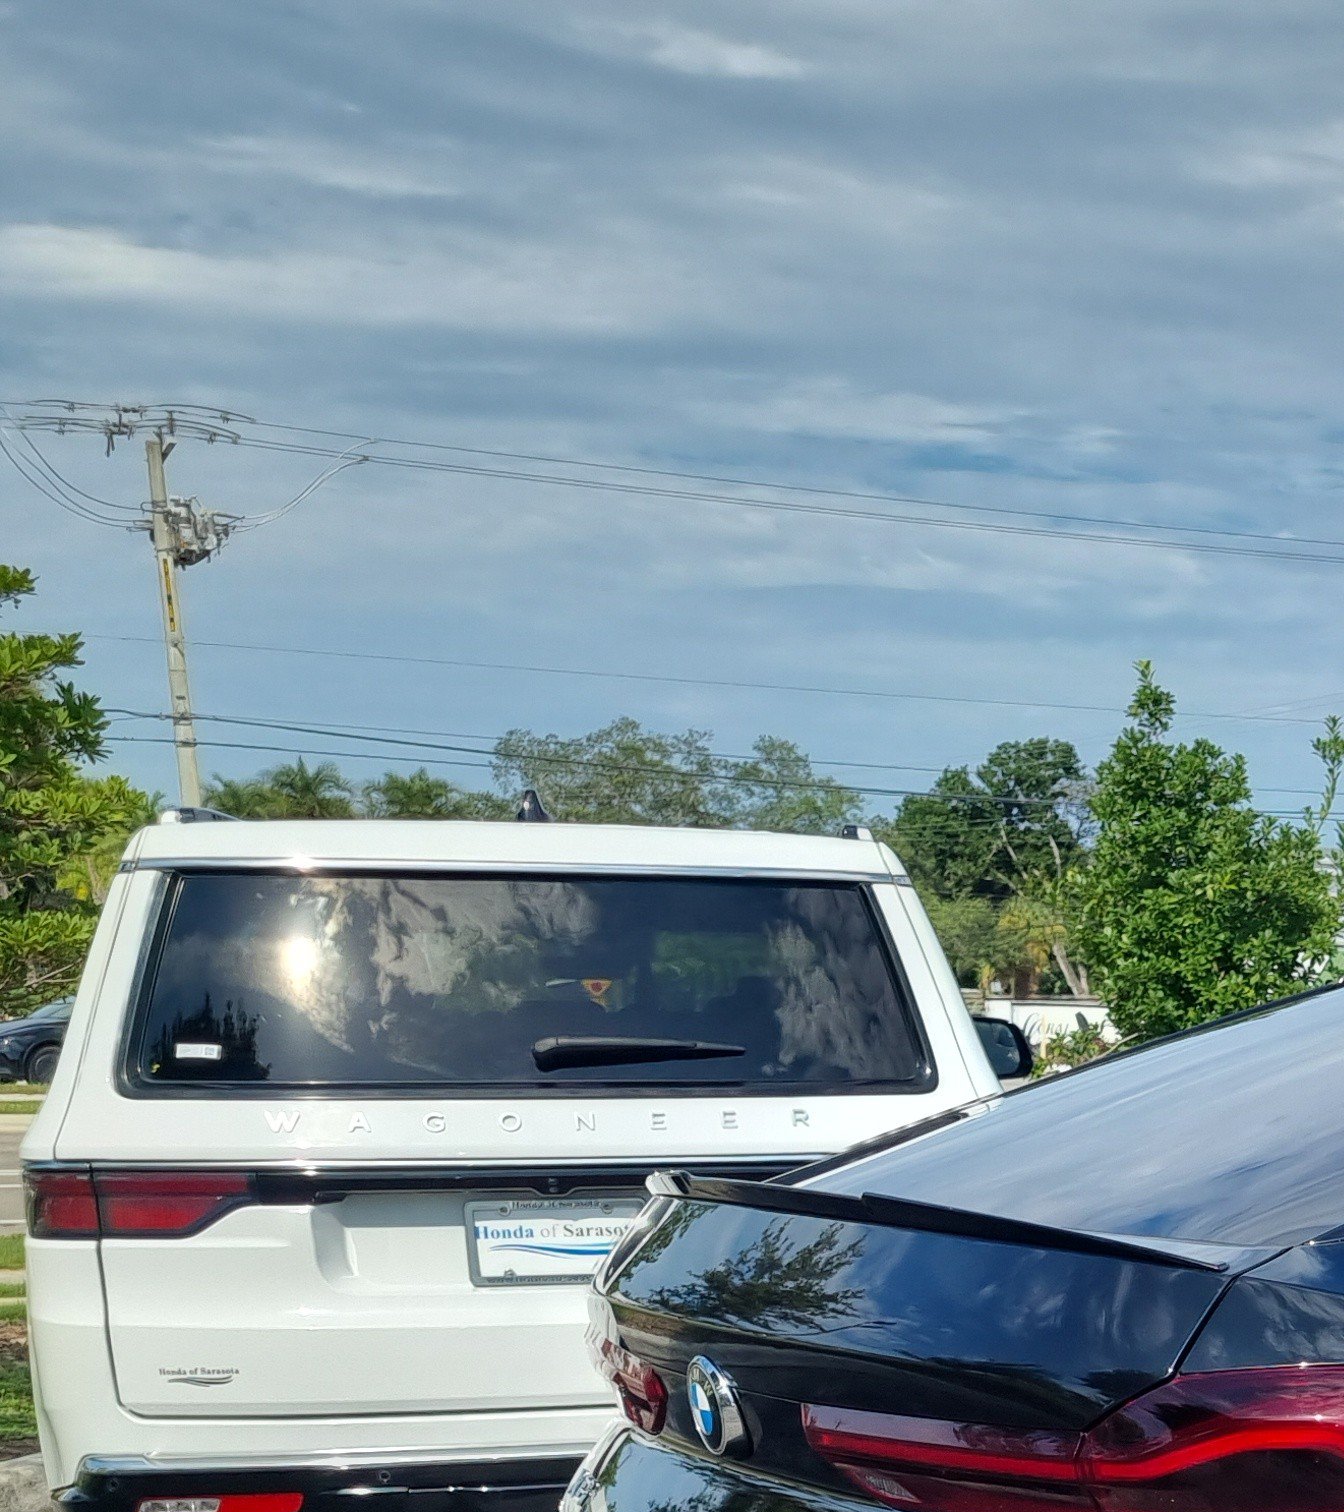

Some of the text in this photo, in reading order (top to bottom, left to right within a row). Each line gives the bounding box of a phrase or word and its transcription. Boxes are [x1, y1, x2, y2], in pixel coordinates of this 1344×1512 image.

[264, 1108, 810, 1134] WAGONEER
[474, 1225, 534, 1240] Honda
[540, 1223, 560, 1238] of
[158, 1367, 240, 1376] Honda of Sarasota
